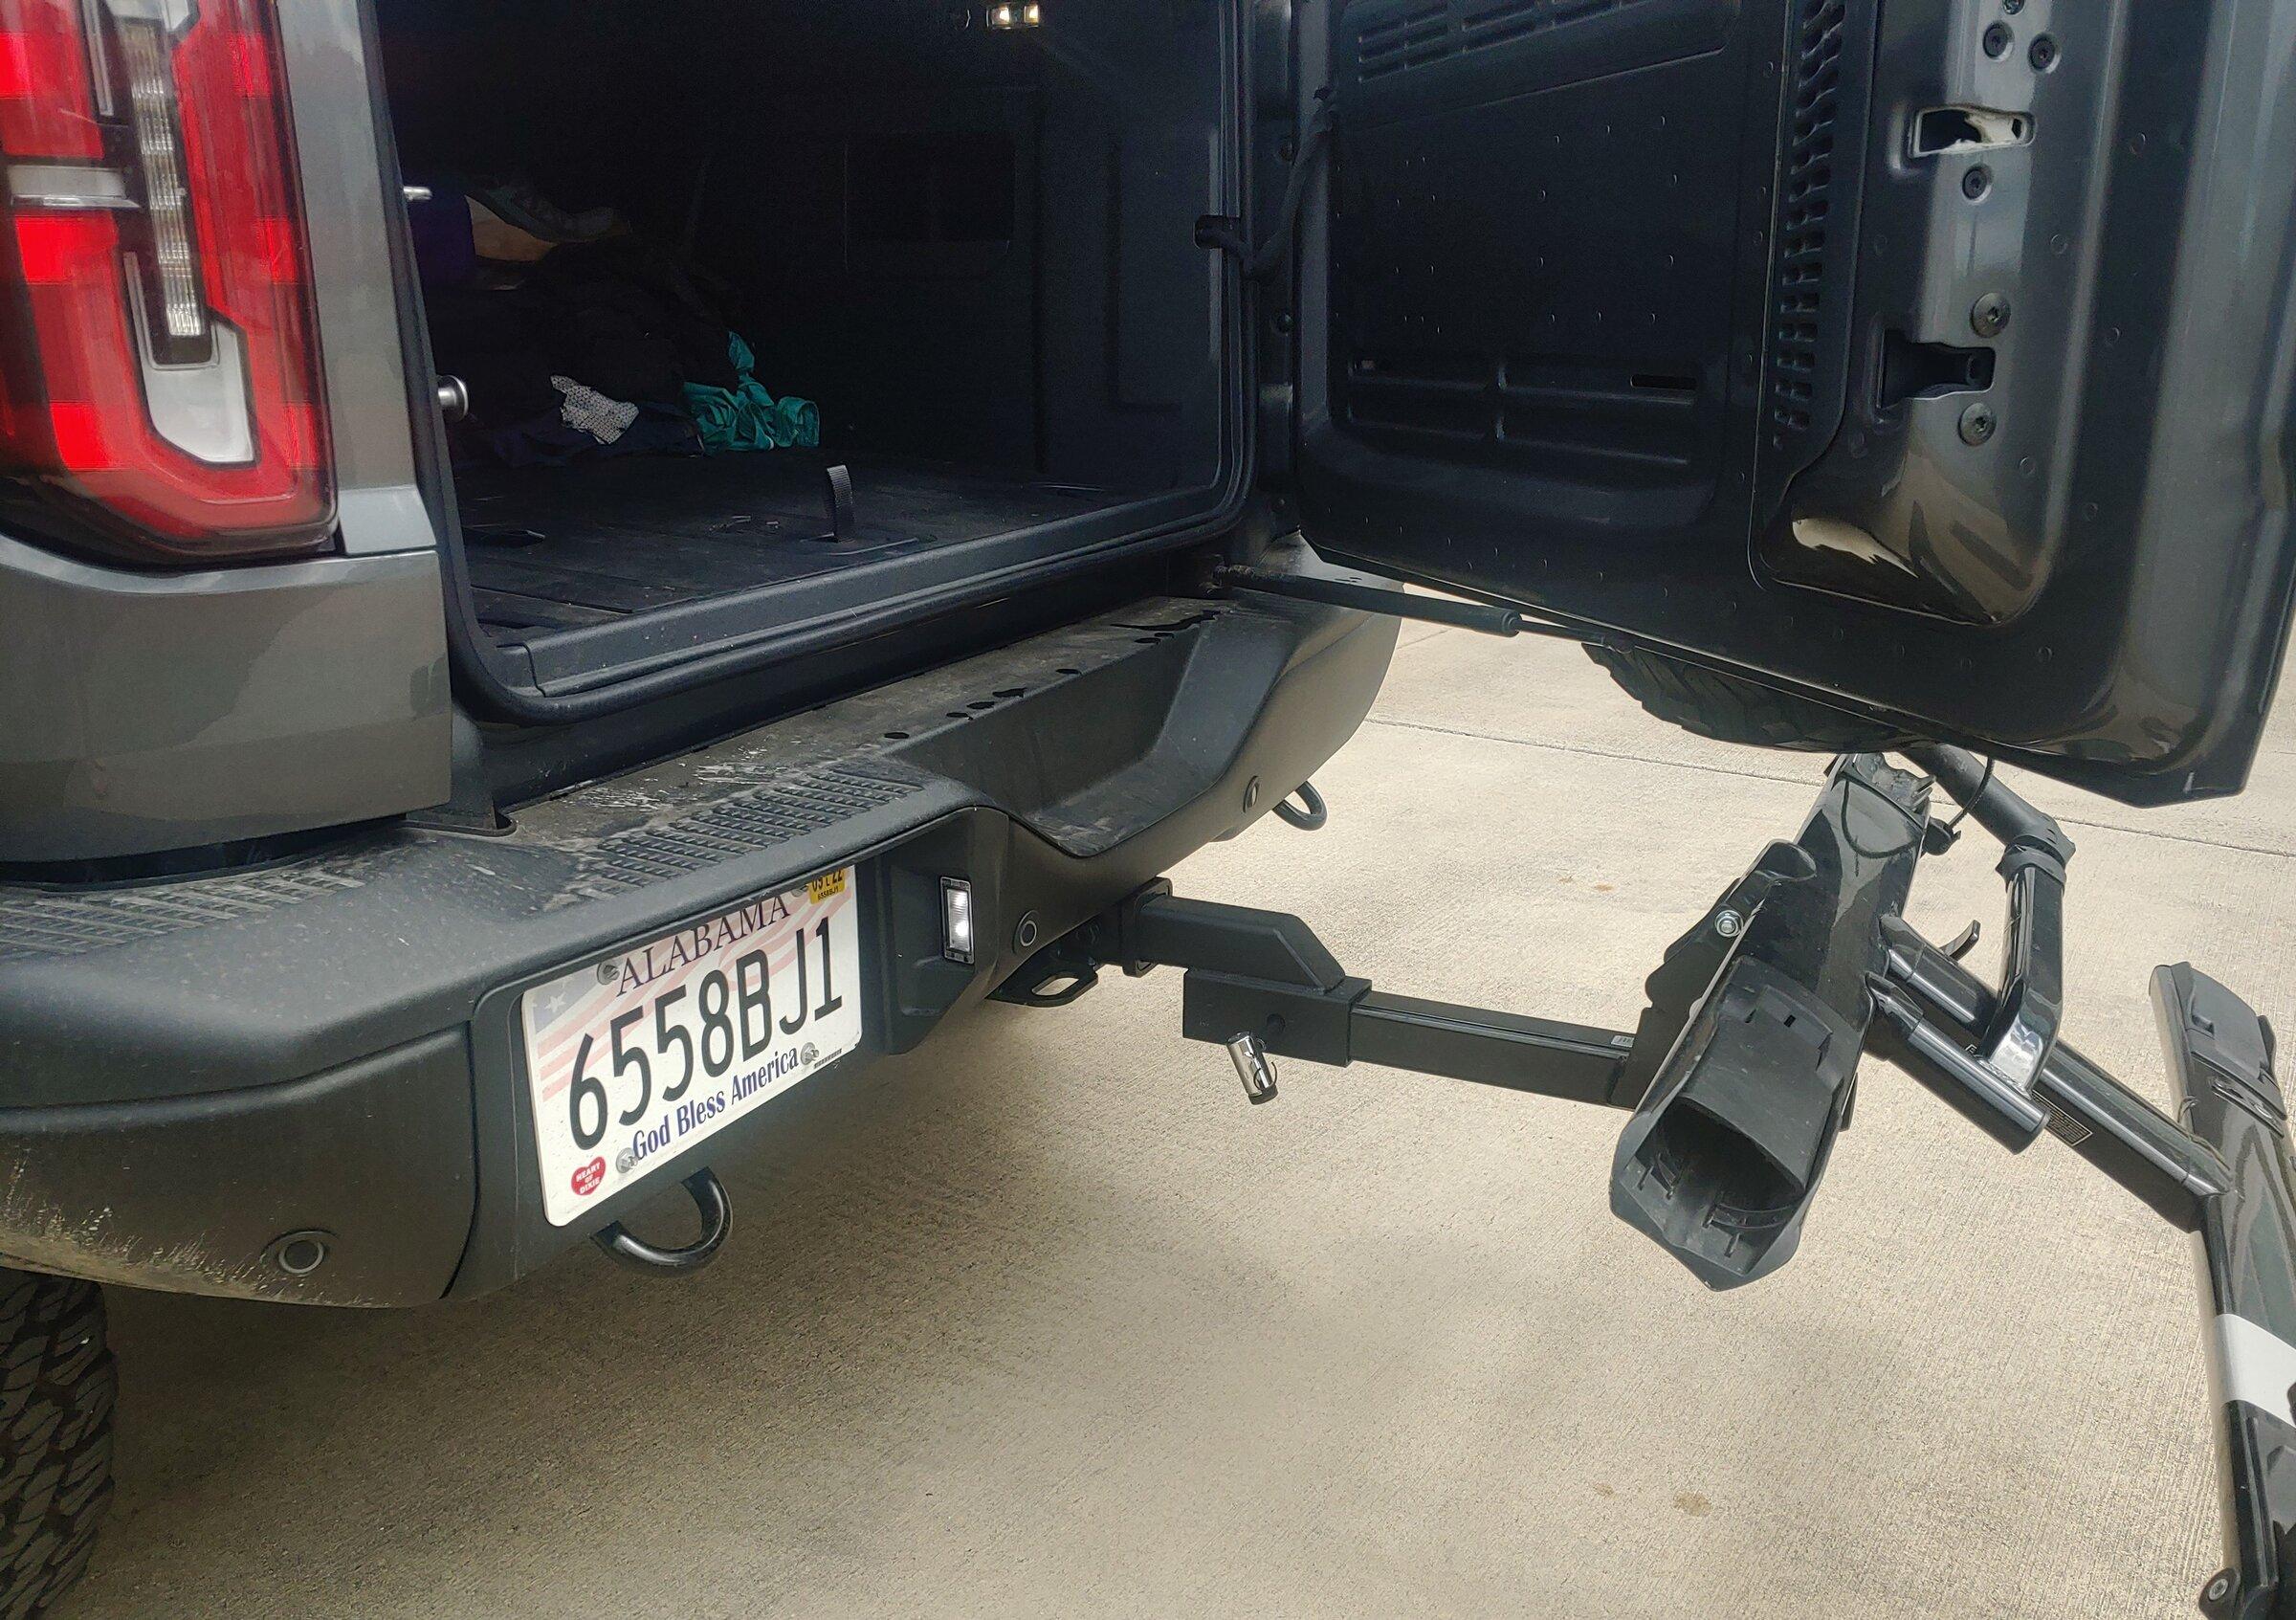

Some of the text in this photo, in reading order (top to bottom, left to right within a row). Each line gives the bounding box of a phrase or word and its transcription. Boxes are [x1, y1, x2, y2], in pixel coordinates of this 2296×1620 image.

[616, 895, 790, 997] ALABAMA
[569, 916, 843, 1150] 6558BJ1
[632, 1113, 671, 1161] God
[675, 1091, 726, 1138] Bless
[730, 1047, 800, 1105] America
[576, 1162, 601, 1183] HEART
[579, 1176, 601, 1194] DIXIE
